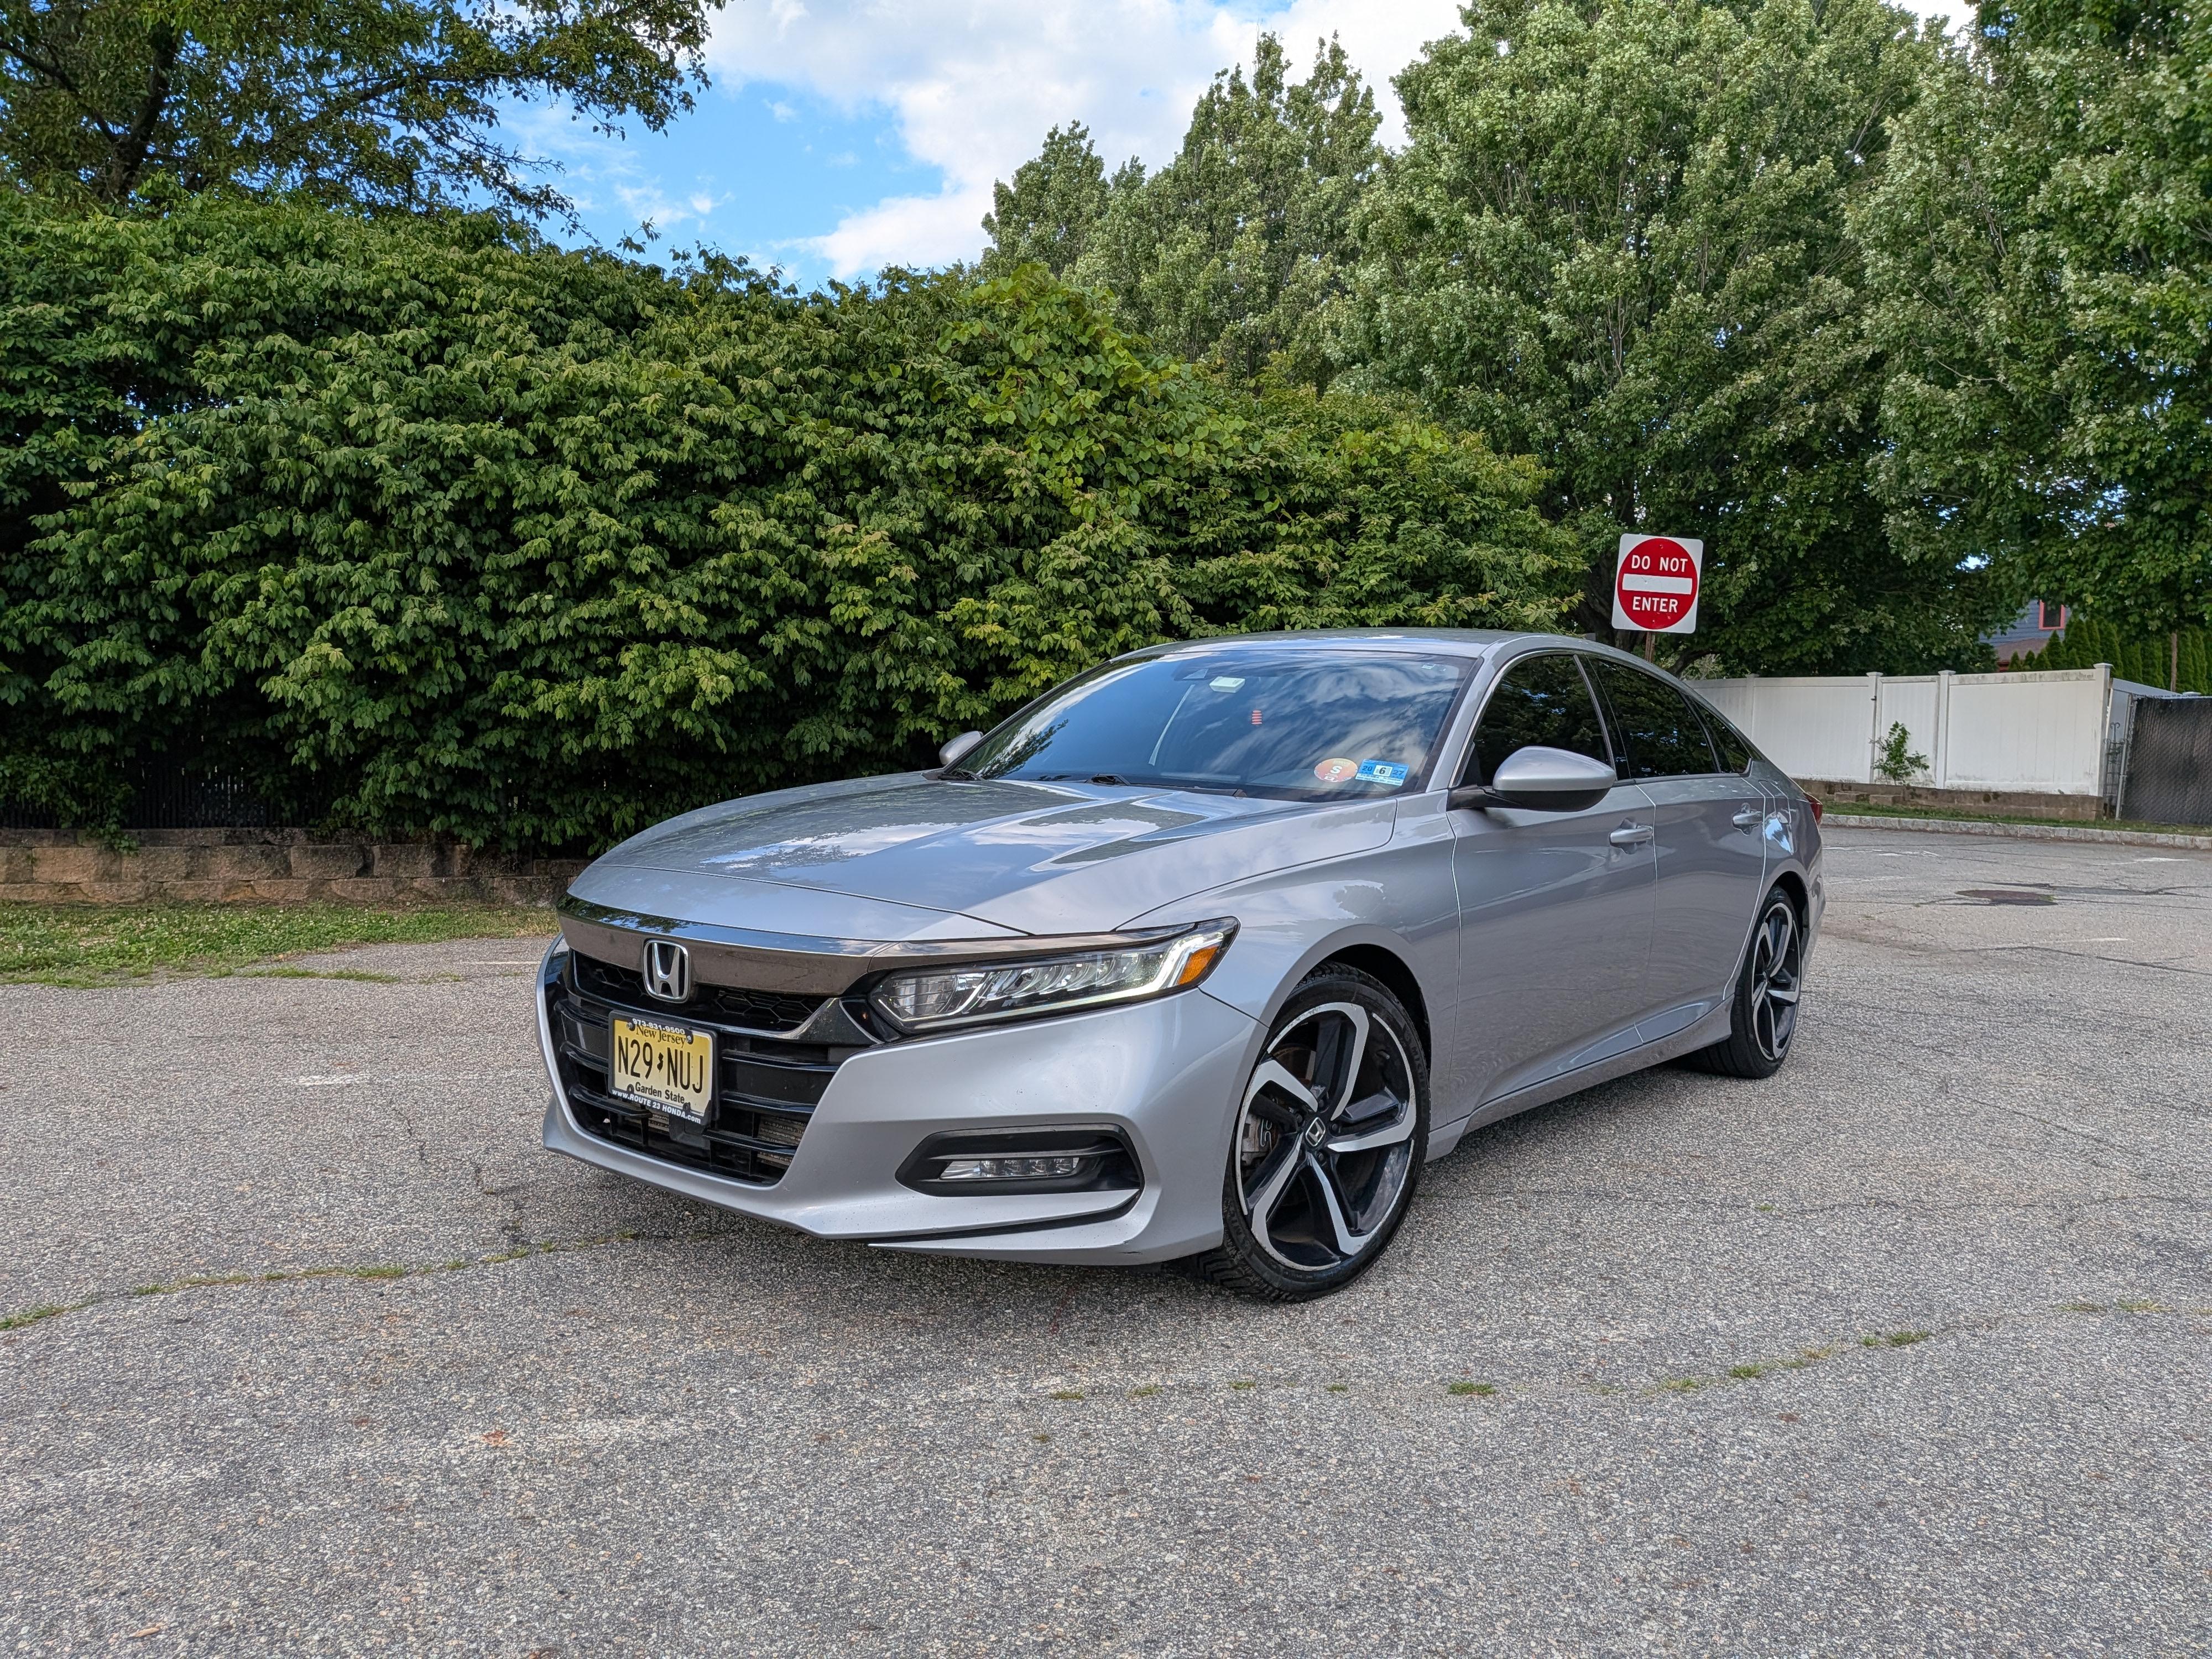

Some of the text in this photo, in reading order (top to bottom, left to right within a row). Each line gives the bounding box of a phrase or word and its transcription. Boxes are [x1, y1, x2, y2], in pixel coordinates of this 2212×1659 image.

[1631, 555, 1688, 572] DO NOT
[1632, 596, 1678, 613] ENTER
[632, 1018, 685, 1035] 973-831-9500
[636, 1025, 687, 1048] New Jersey
[618, 1036, 703, 1094] N29 NUJ
[635, 1082, 685, 1104] Garden State
[612, 1089, 701, 1124] www.ROUTE 23 HONDA.com
